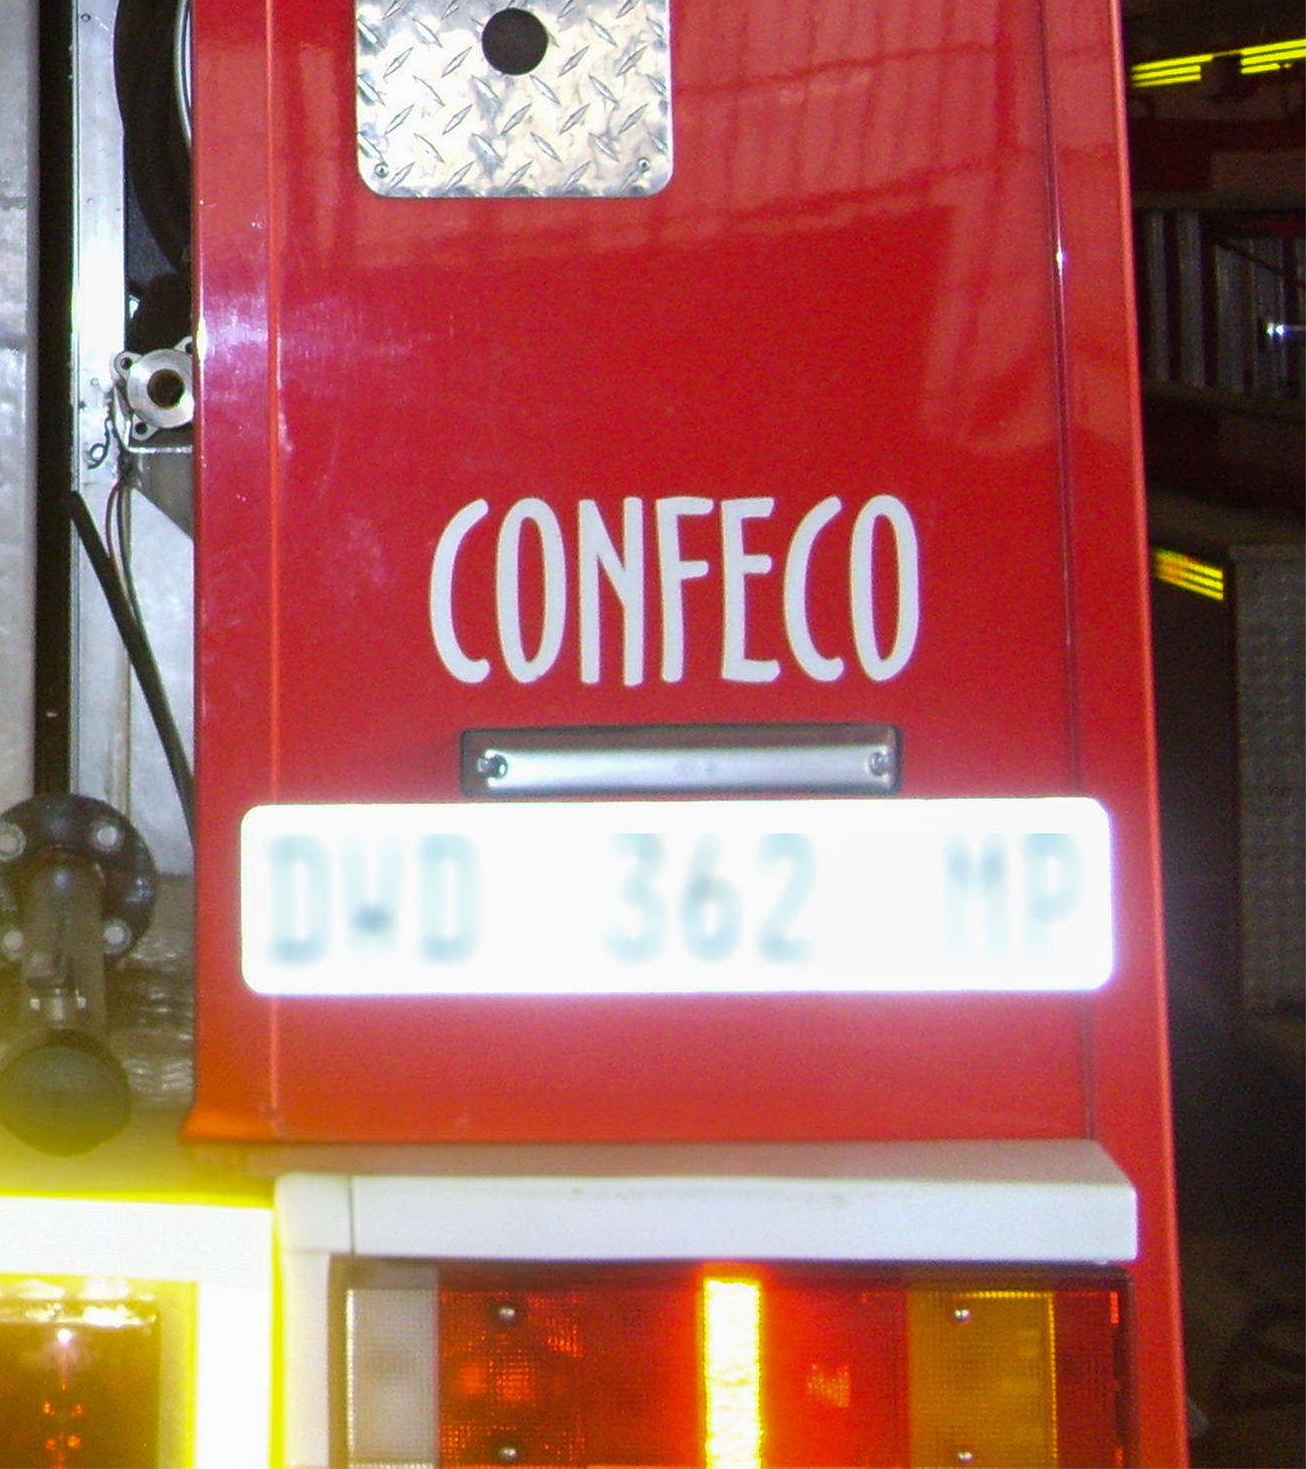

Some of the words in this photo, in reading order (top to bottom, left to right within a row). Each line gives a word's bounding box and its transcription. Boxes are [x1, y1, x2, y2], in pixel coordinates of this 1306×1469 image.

[428, 494, 921, 686] CONFECO
[602, 832, 819, 968] 362
[945, 832, 1083, 960] MP
